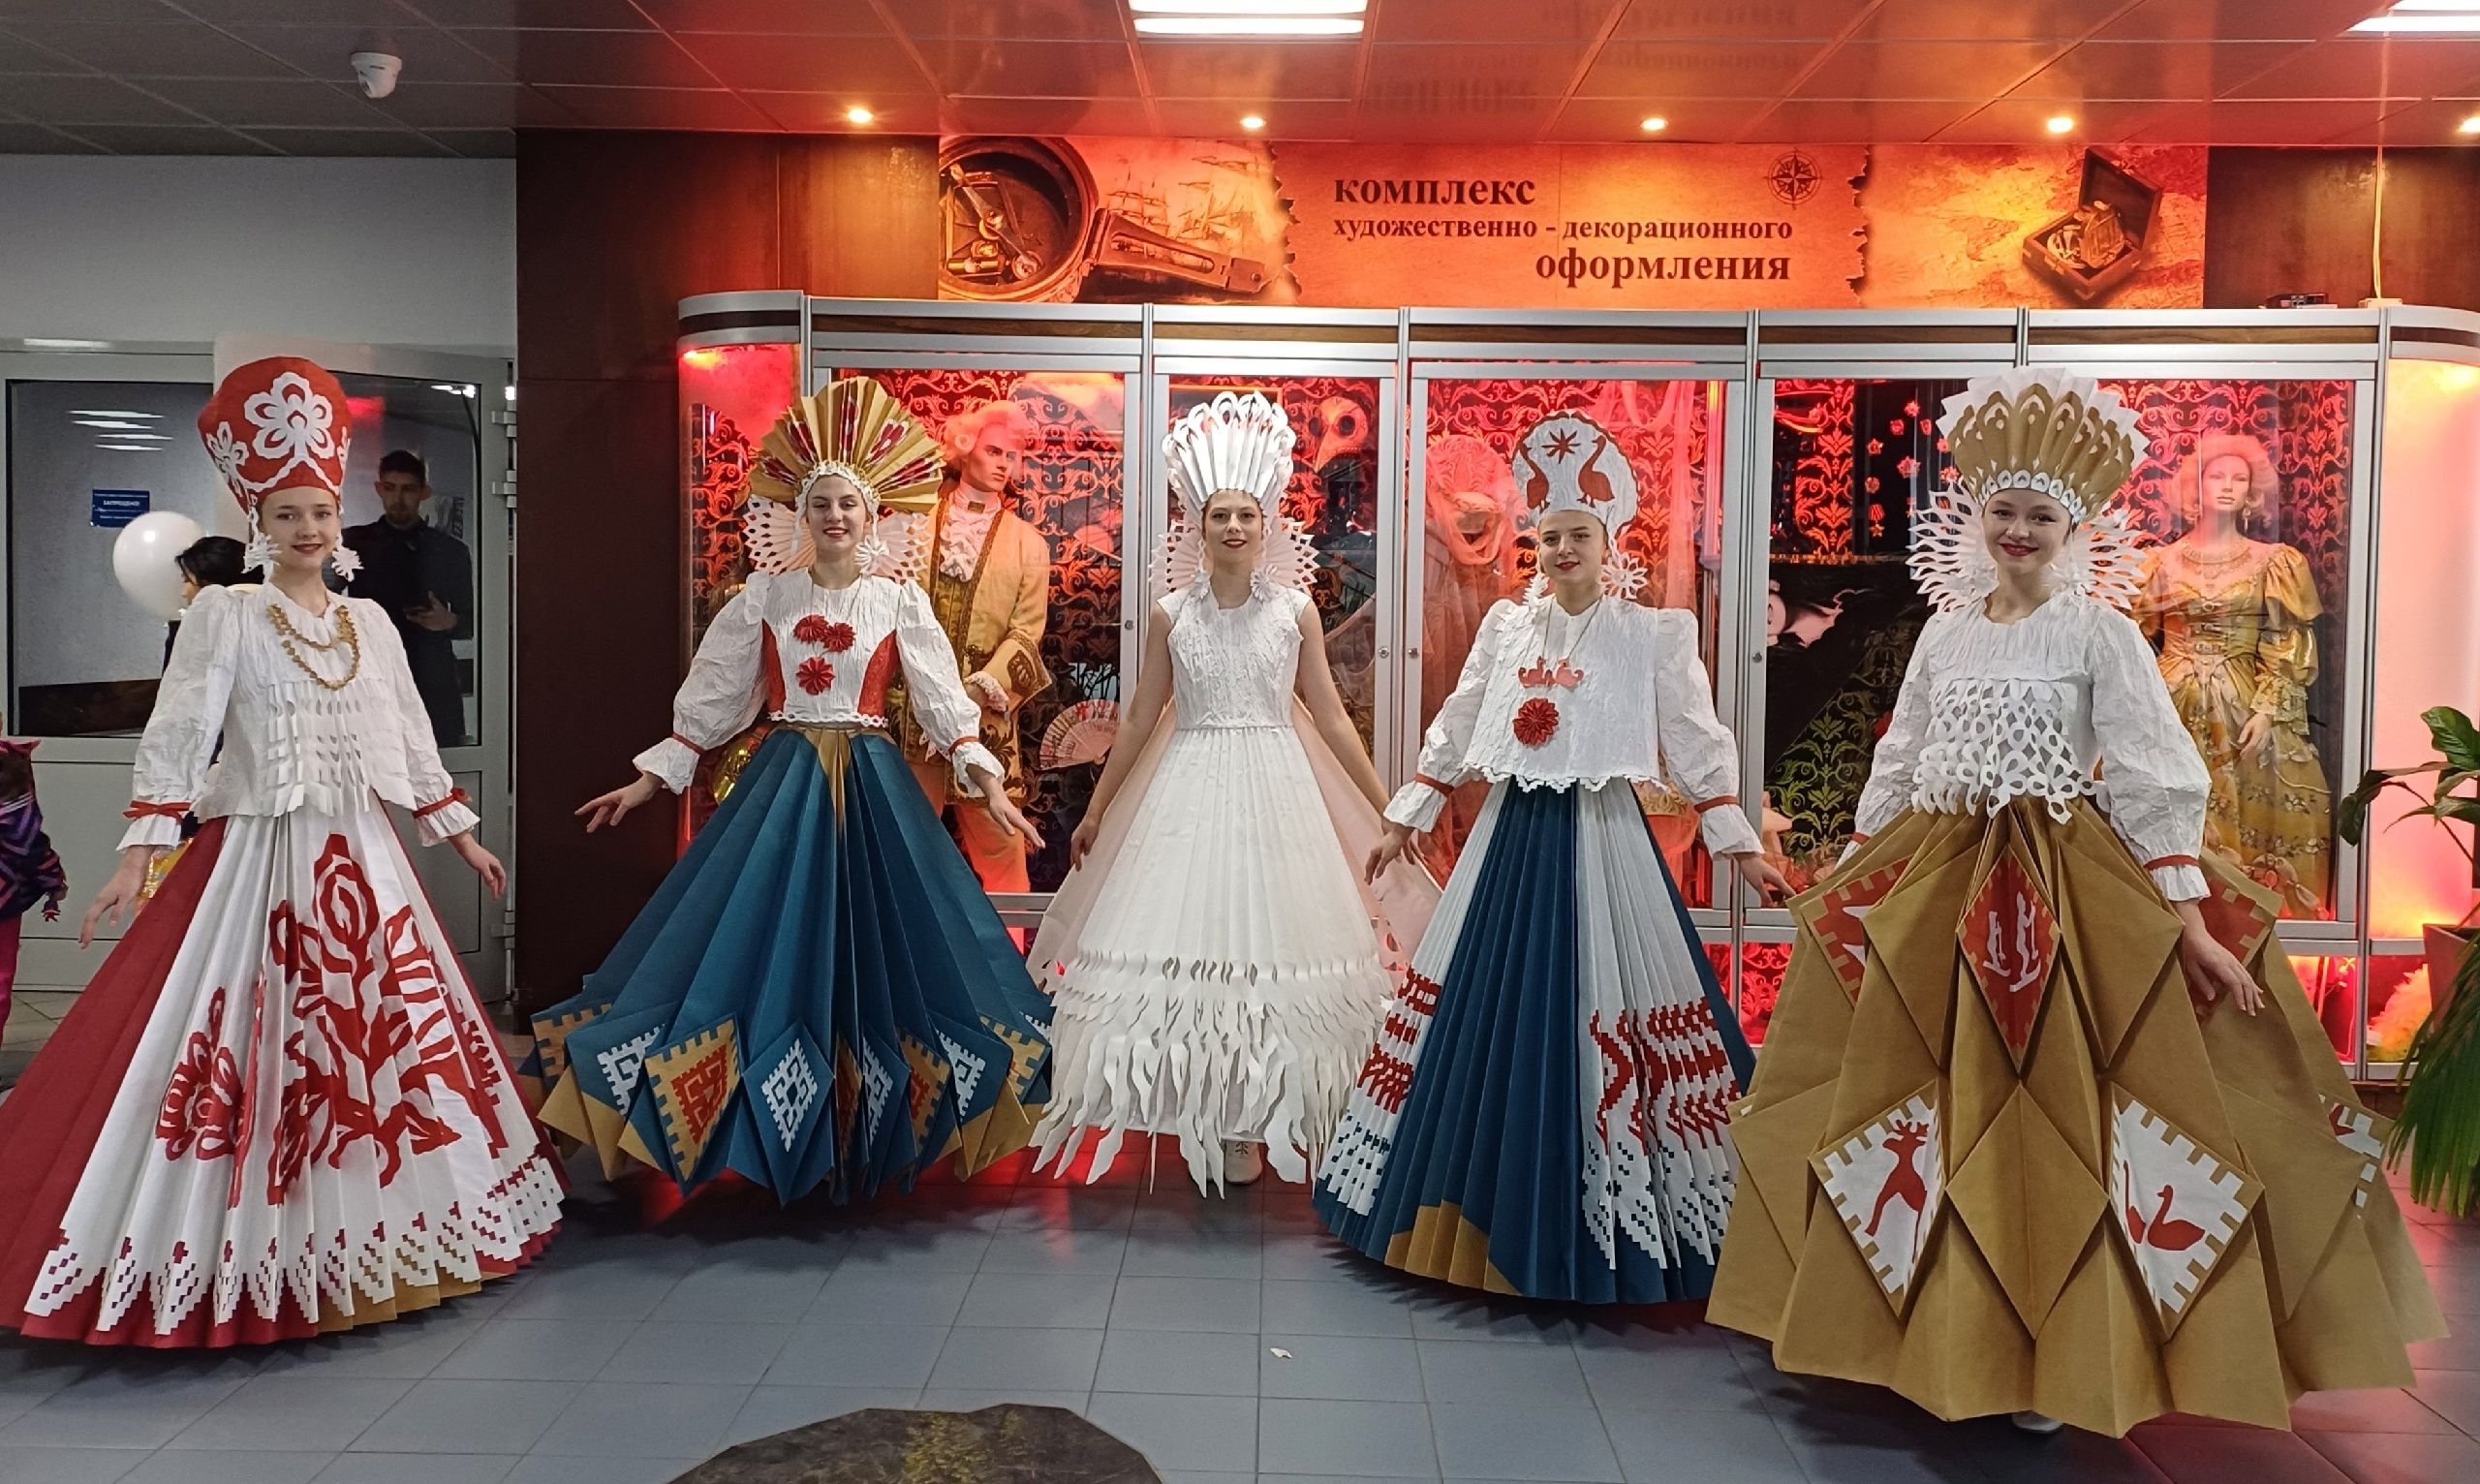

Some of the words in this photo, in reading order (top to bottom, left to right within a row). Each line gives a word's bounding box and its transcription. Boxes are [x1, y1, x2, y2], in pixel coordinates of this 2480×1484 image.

[1334, 178, 1535, 205] комплекс
[1333, 219, 1537, 241] художественно
[1563, 221, 1792, 243] декорационного
[1535, 247, 1790, 289] оформления
